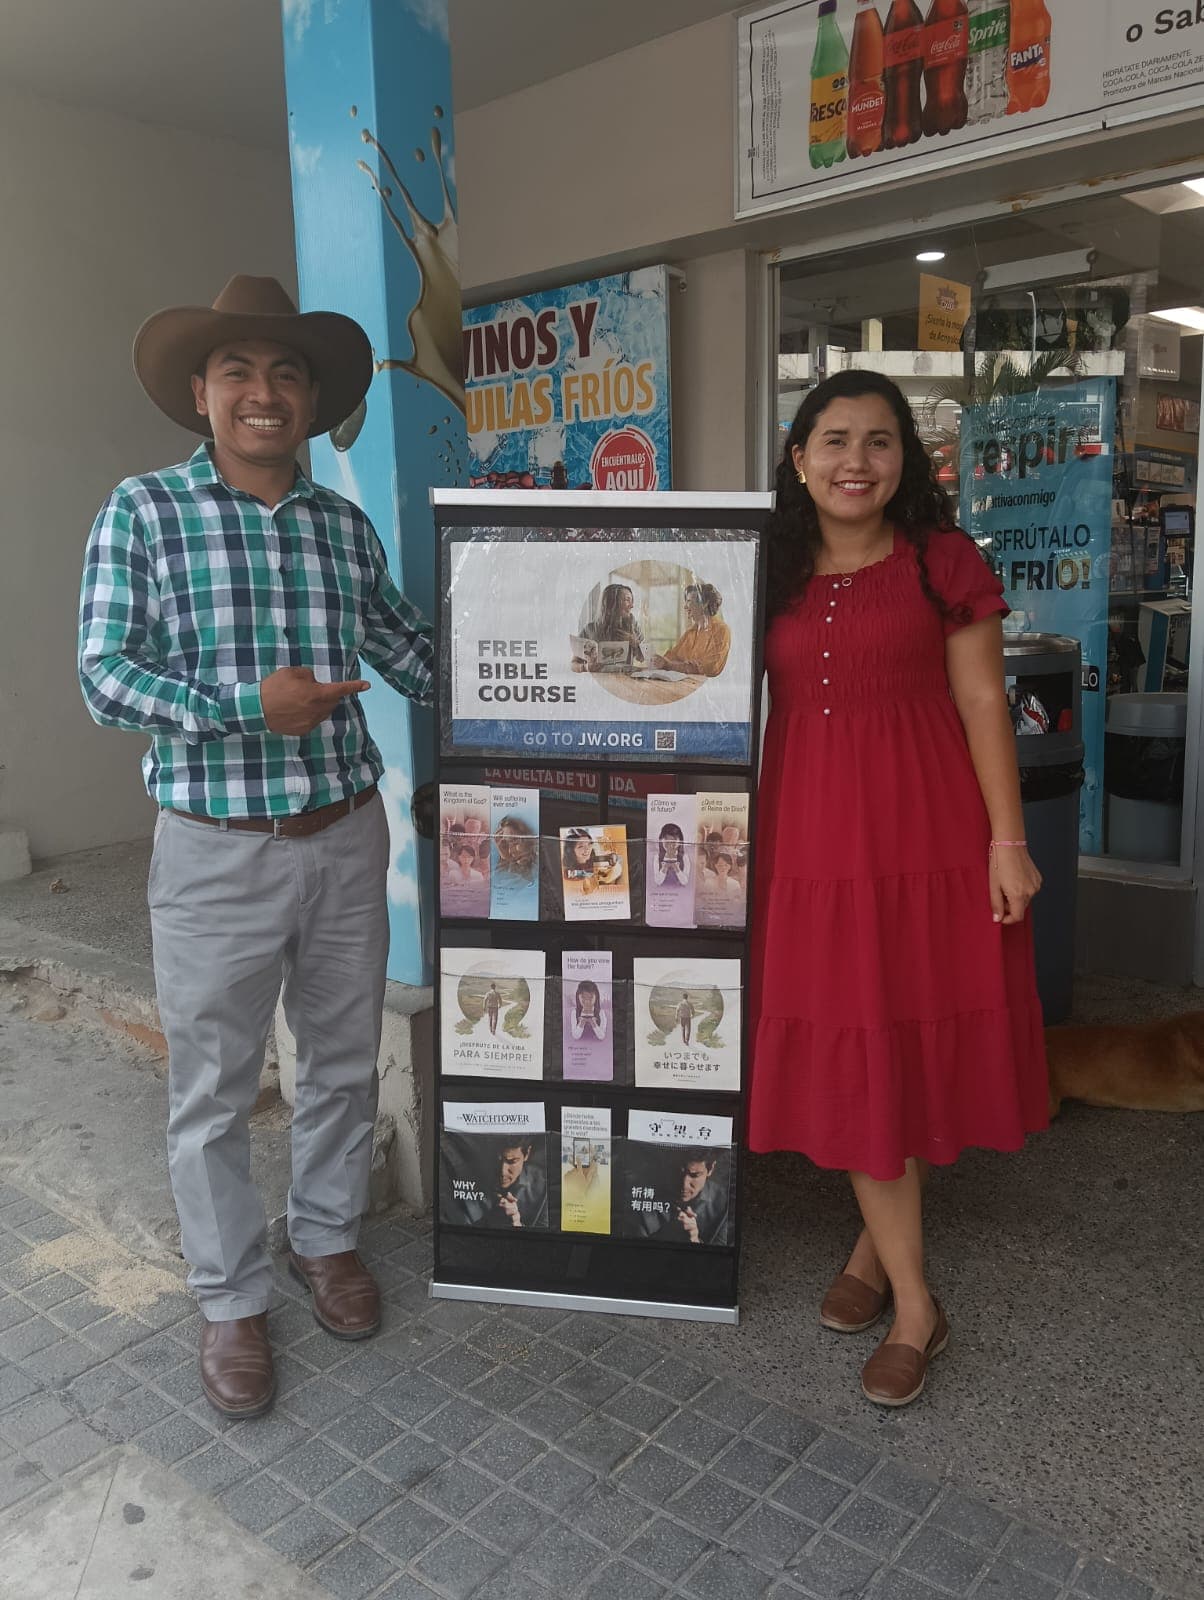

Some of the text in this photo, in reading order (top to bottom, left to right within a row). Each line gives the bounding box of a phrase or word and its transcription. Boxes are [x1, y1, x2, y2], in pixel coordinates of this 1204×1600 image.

[968, 19, 1007, 47] Sprite
[1126, 24, 1143, 43] o
[1010, 43, 1044, 67] FANTA
[851, 97, 885, 113] MUNDET
[462, 301, 598, 380] VINOS Y
[466, 358, 654, 434] UILAS FRÍOS
[606, 463, 645, 491] AQUÍ
[982, 522, 1091, 551] ISFRÚTALO
[1010, 552, 1091, 591] FRÍO!
[477, 640, 538, 658] FREE
[478, 663, 548, 680] BIBLE
[478, 685, 577, 703] COURSE
[523, 732, 643, 747] GO TO JW.ORG
[556, 771, 574, 786] DE
[574, 773, 596, 788] TU
[610, 776, 636, 793] IDA
[453, 1049, 532, 1062] PARA SIEMPRE!
[462, 1113, 529, 1123] WATCHTOWER
[453, 1180, 475, 1191] WHY
[453, 1190, 485, 1201] PRAY?
